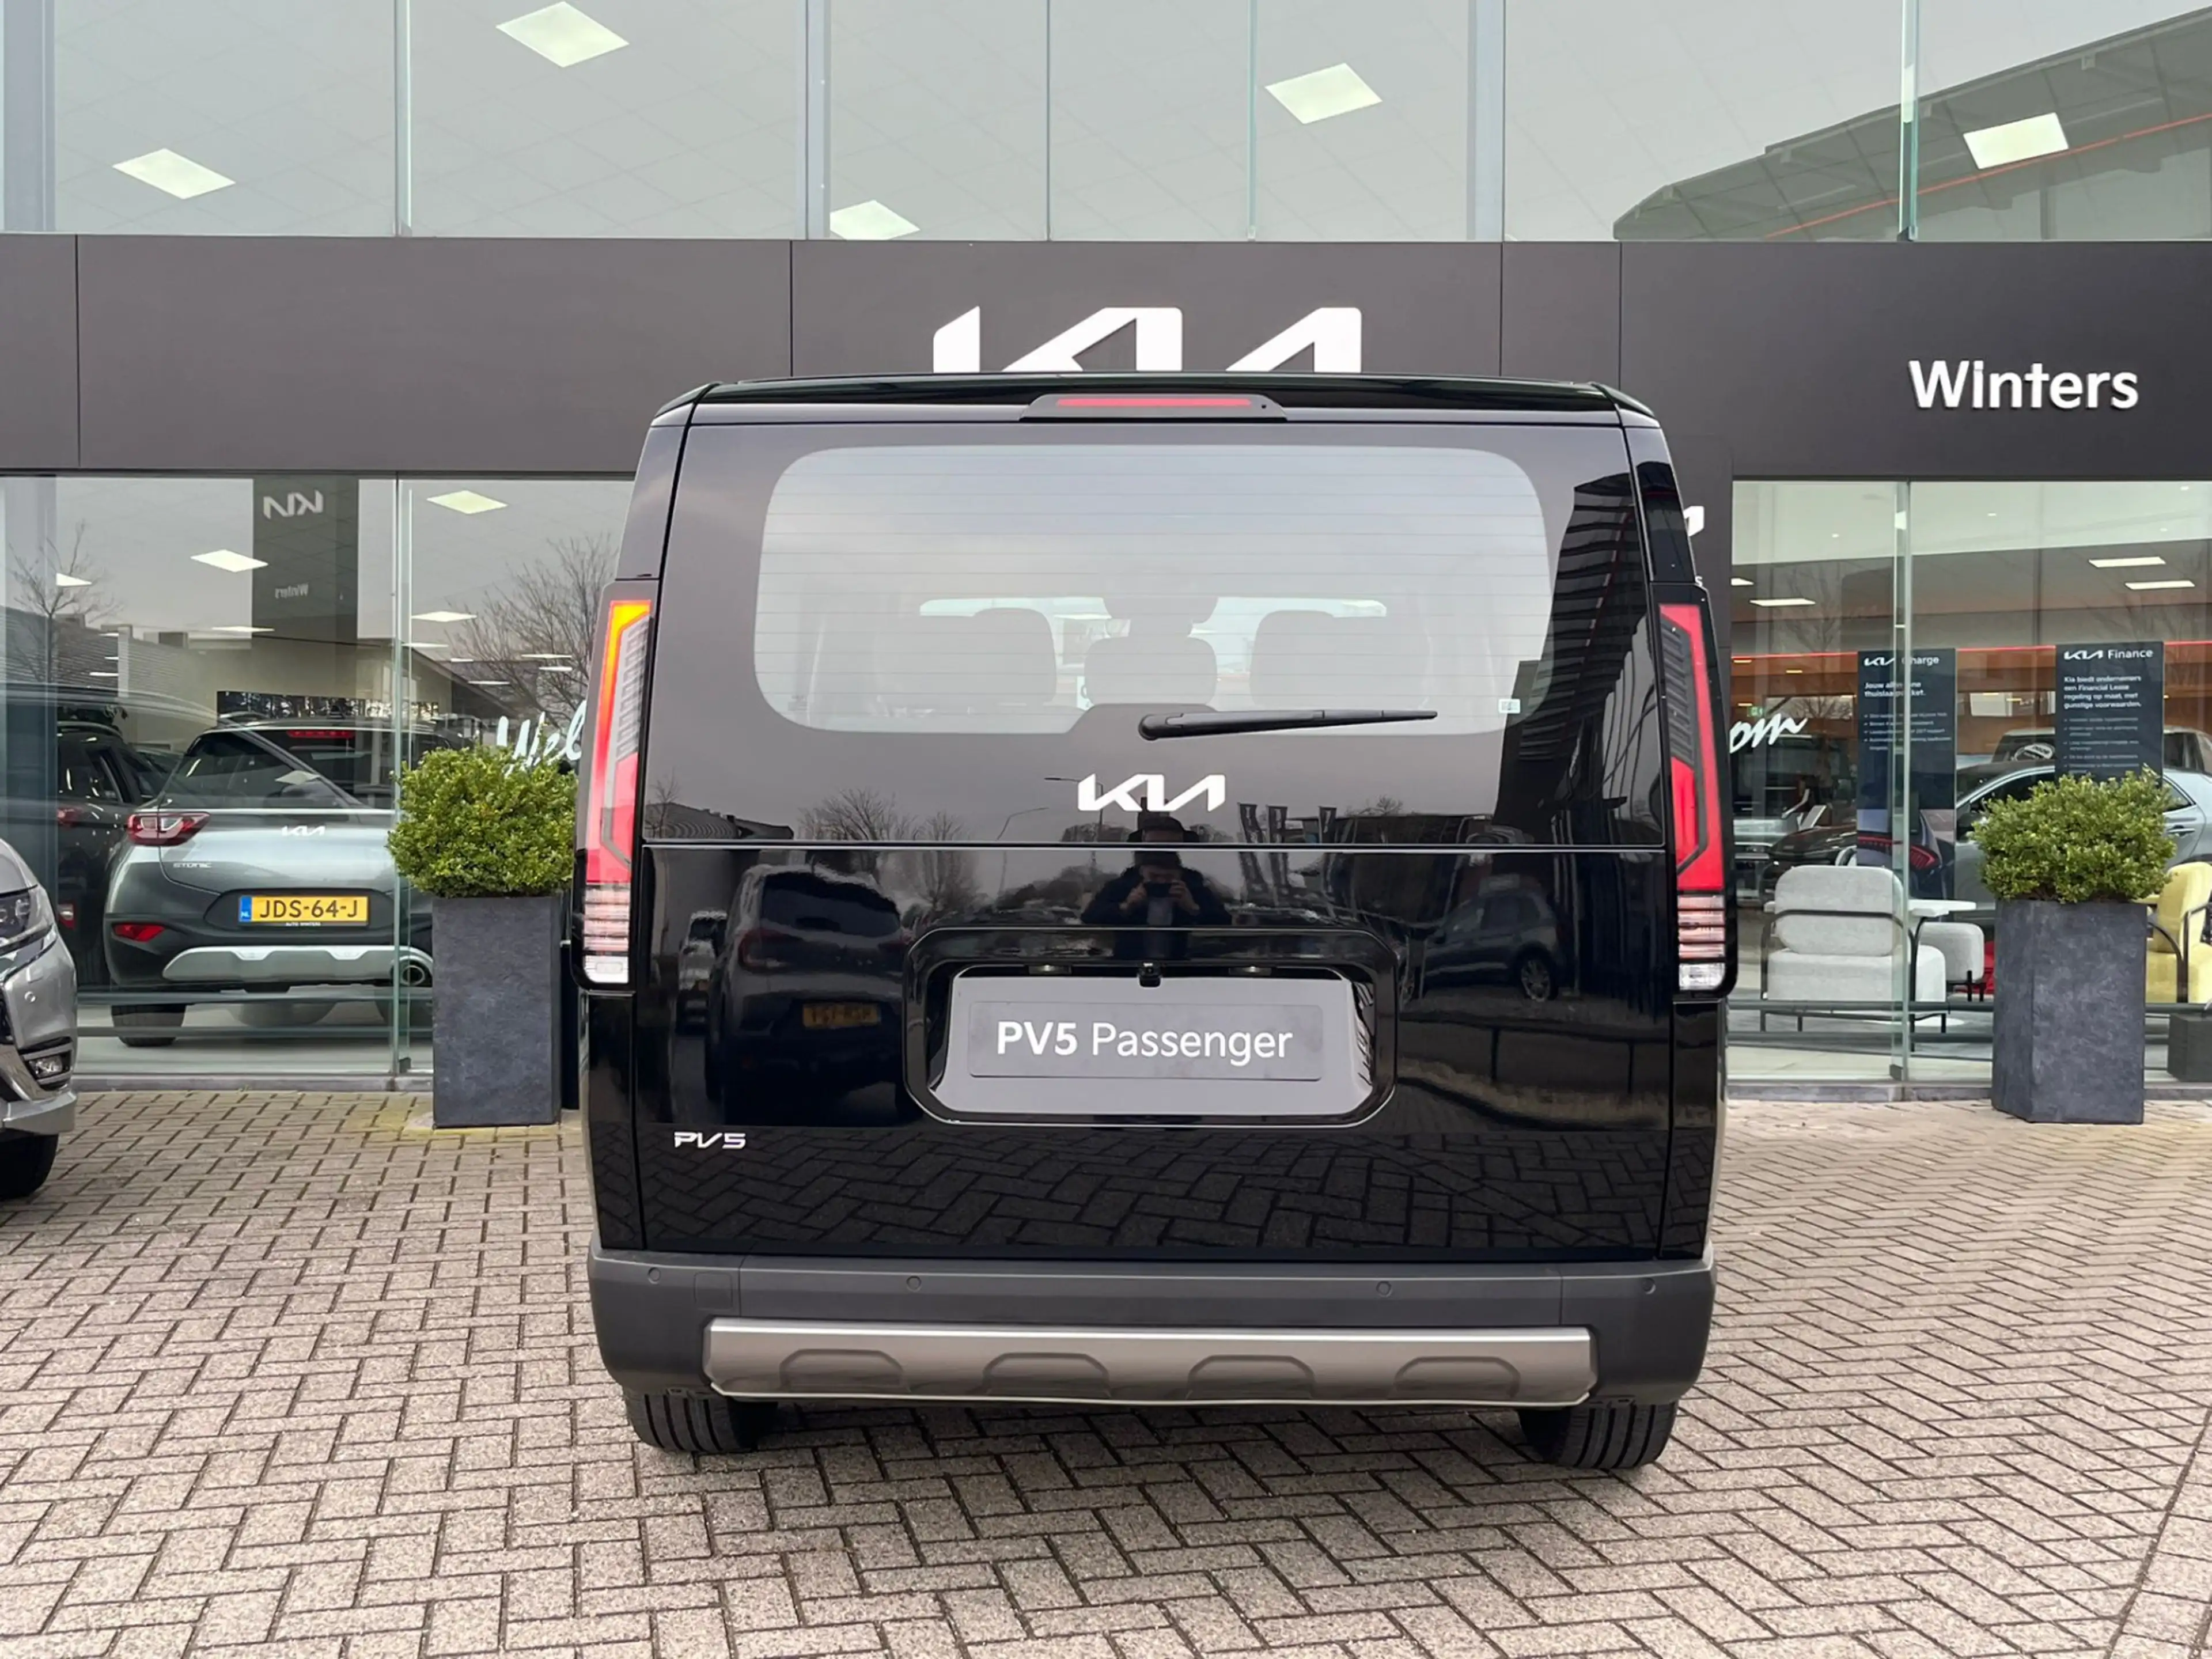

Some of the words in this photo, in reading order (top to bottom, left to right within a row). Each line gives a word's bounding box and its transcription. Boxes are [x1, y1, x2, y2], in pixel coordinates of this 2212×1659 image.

[1908, 361, 2138, 408] Winters
[2064, 650, 2103, 660] KIA
[2108, 649, 2153, 659] Finance
[1078, 773, 1225, 812] KIA
[281, 825, 325, 836] KIA
[260, 900, 358, 918] JDS-64-J
[997, 1021, 1078, 1055] PV5
[1093, 1022, 1293, 1066] Passenger
[674, 1132, 746, 1149] PV5
